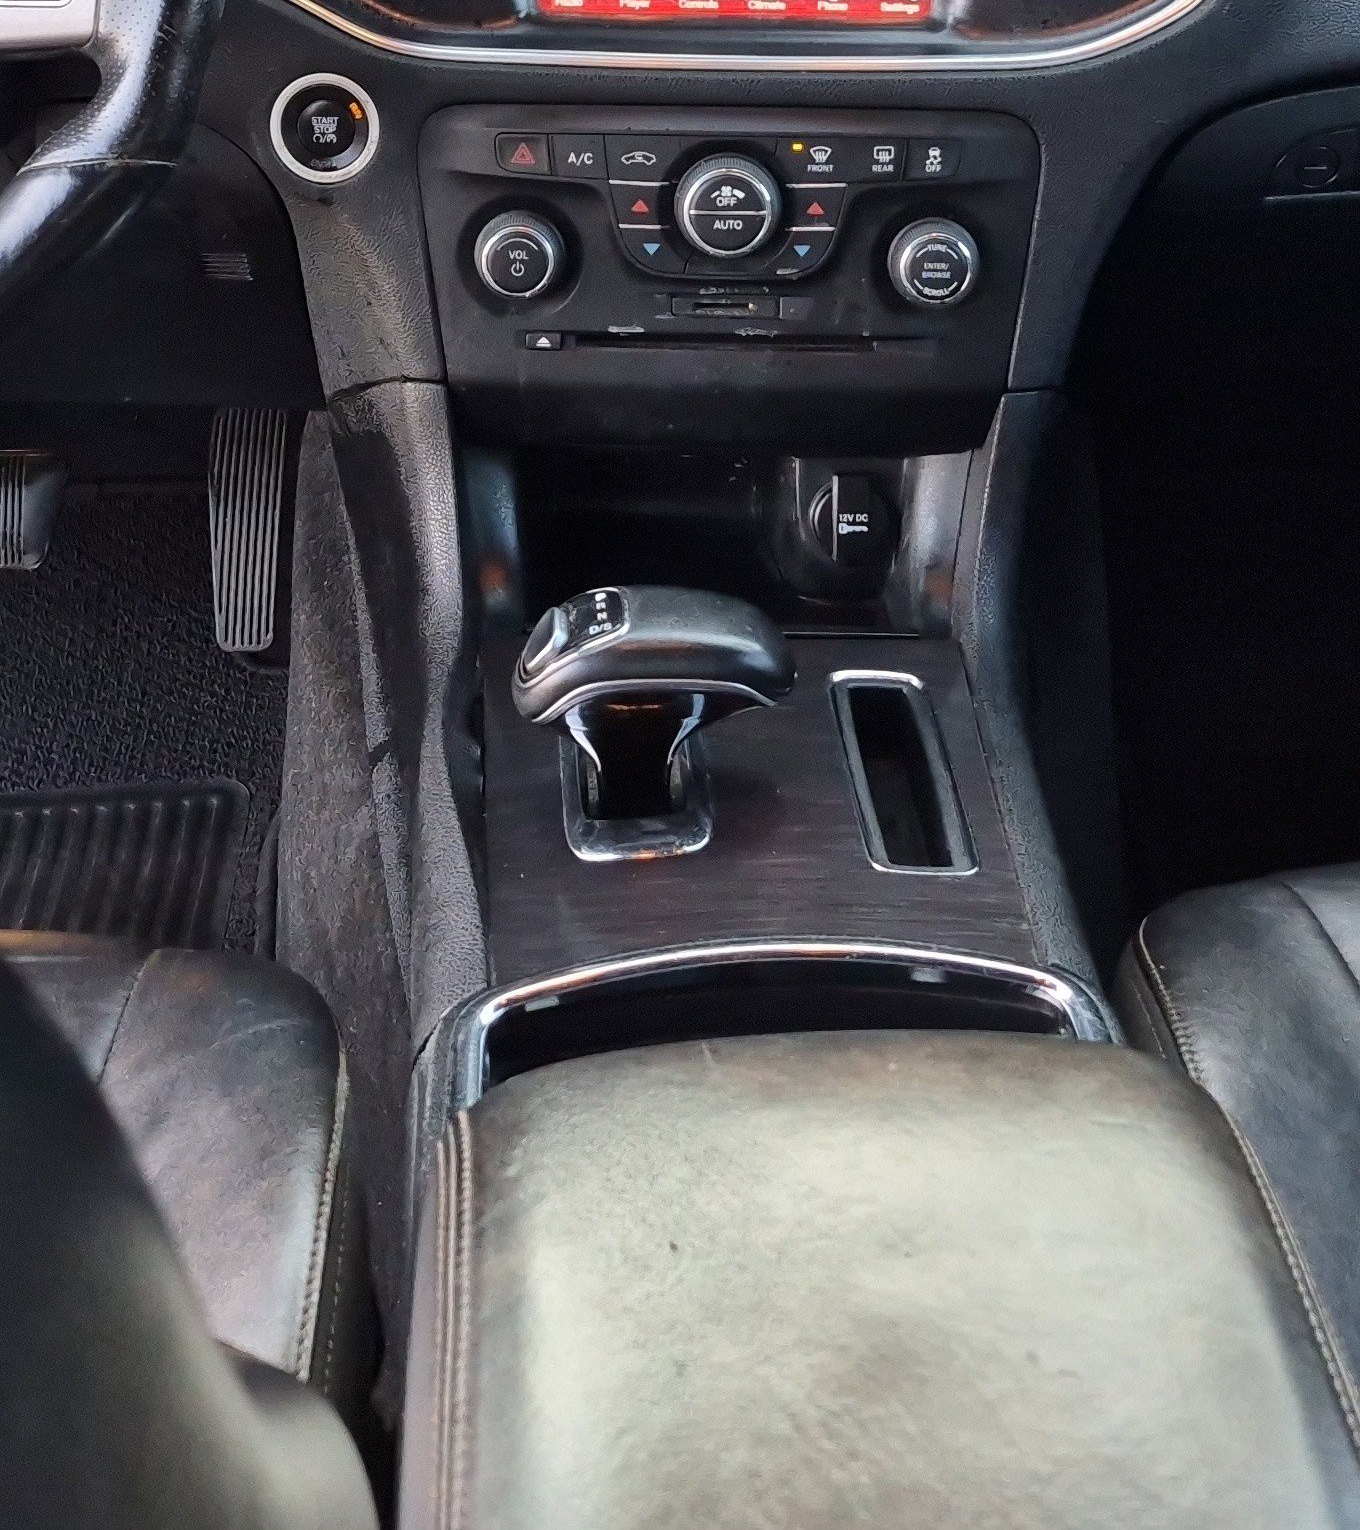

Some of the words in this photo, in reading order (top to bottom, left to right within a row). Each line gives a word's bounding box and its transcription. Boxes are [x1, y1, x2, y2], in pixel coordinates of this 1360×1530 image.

[312, 117, 338, 125] START
[314, 126, 336, 134] STOP
[568, 152, 593, 166] A/C
[807, 164, 834, 172] FRONT
[872, 164, 894, 172] REAR
[925, 164, 943, 173] OFF
[716, 197, 737, 206] OFF
[713, 220, 743, 230] AUTO
[509, 251, 529, 260] VOL
[839, 514, 854, 522] 12V
[856, 514, 868, 522] DC
